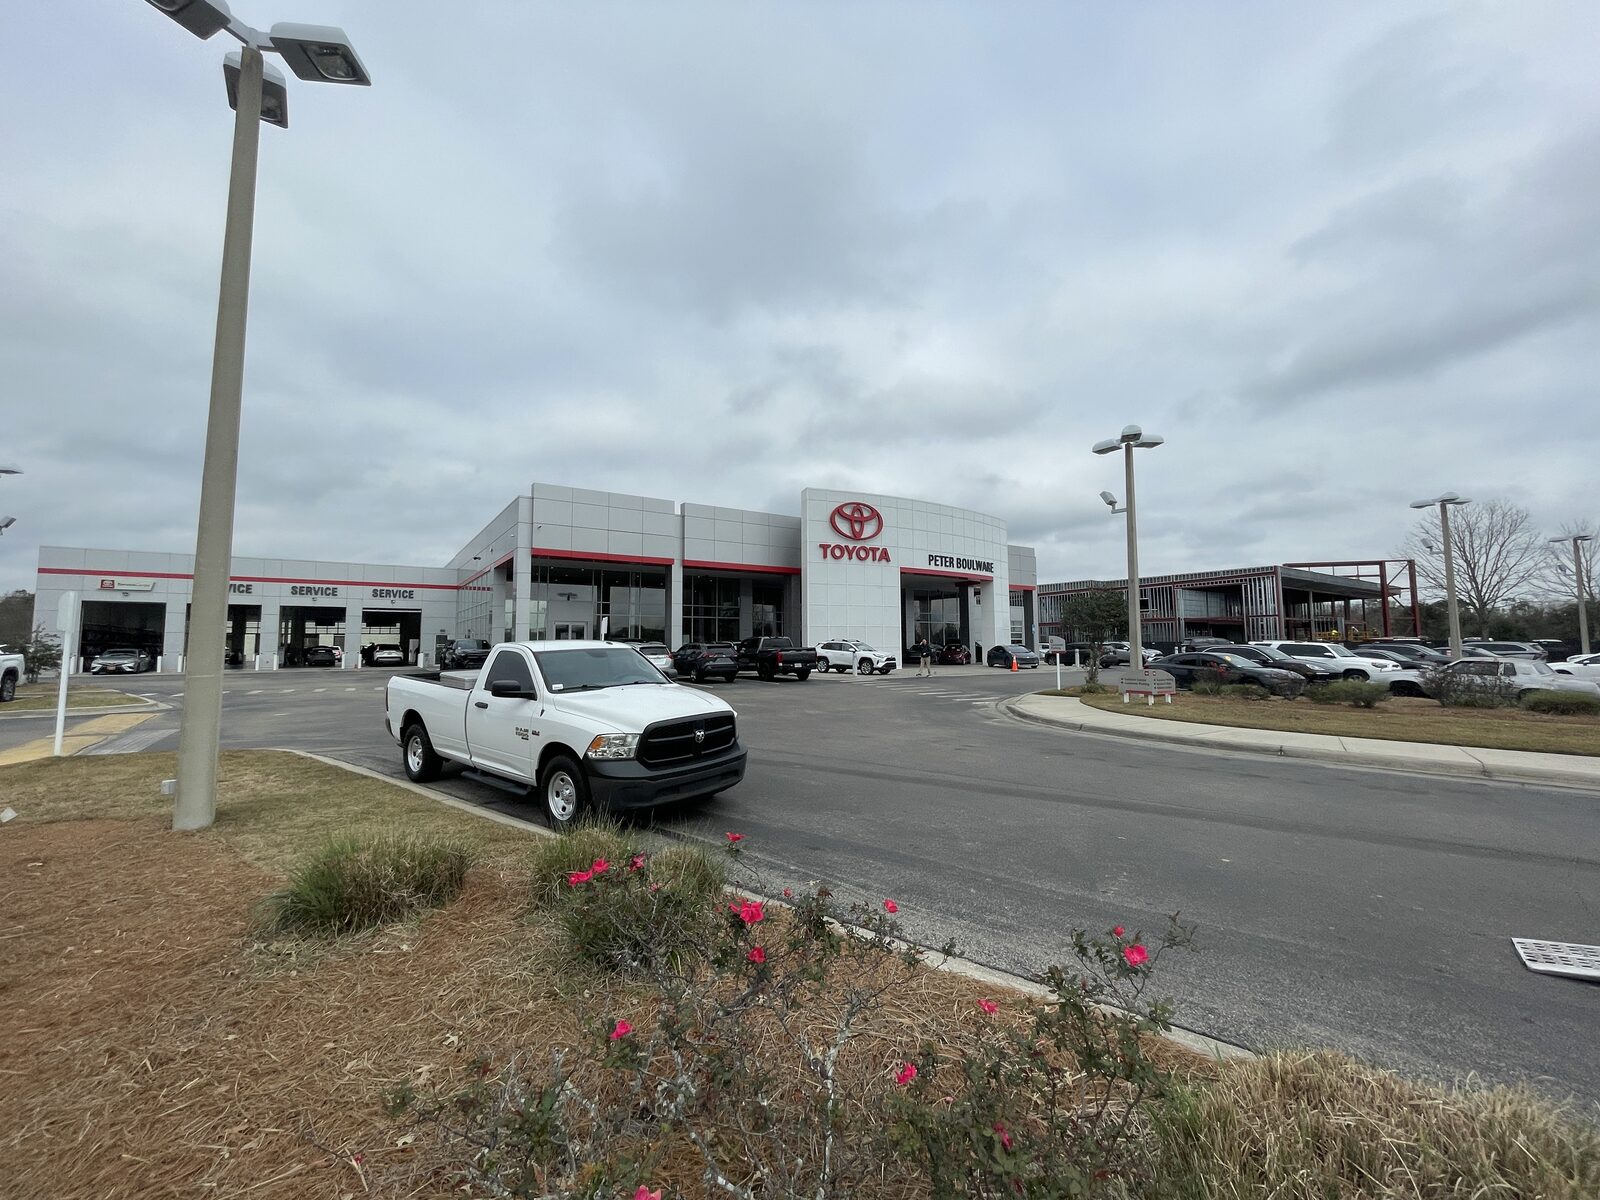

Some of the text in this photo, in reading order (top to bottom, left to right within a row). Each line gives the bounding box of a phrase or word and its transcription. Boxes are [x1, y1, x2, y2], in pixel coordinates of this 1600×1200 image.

[818, 543, 891, 562] TOYOTA
[928, 554, 994, 573] PETER BOULWARE
[290, 585, 338, 597] SERVICE
[372, 588, 415, 599] SERVICE
